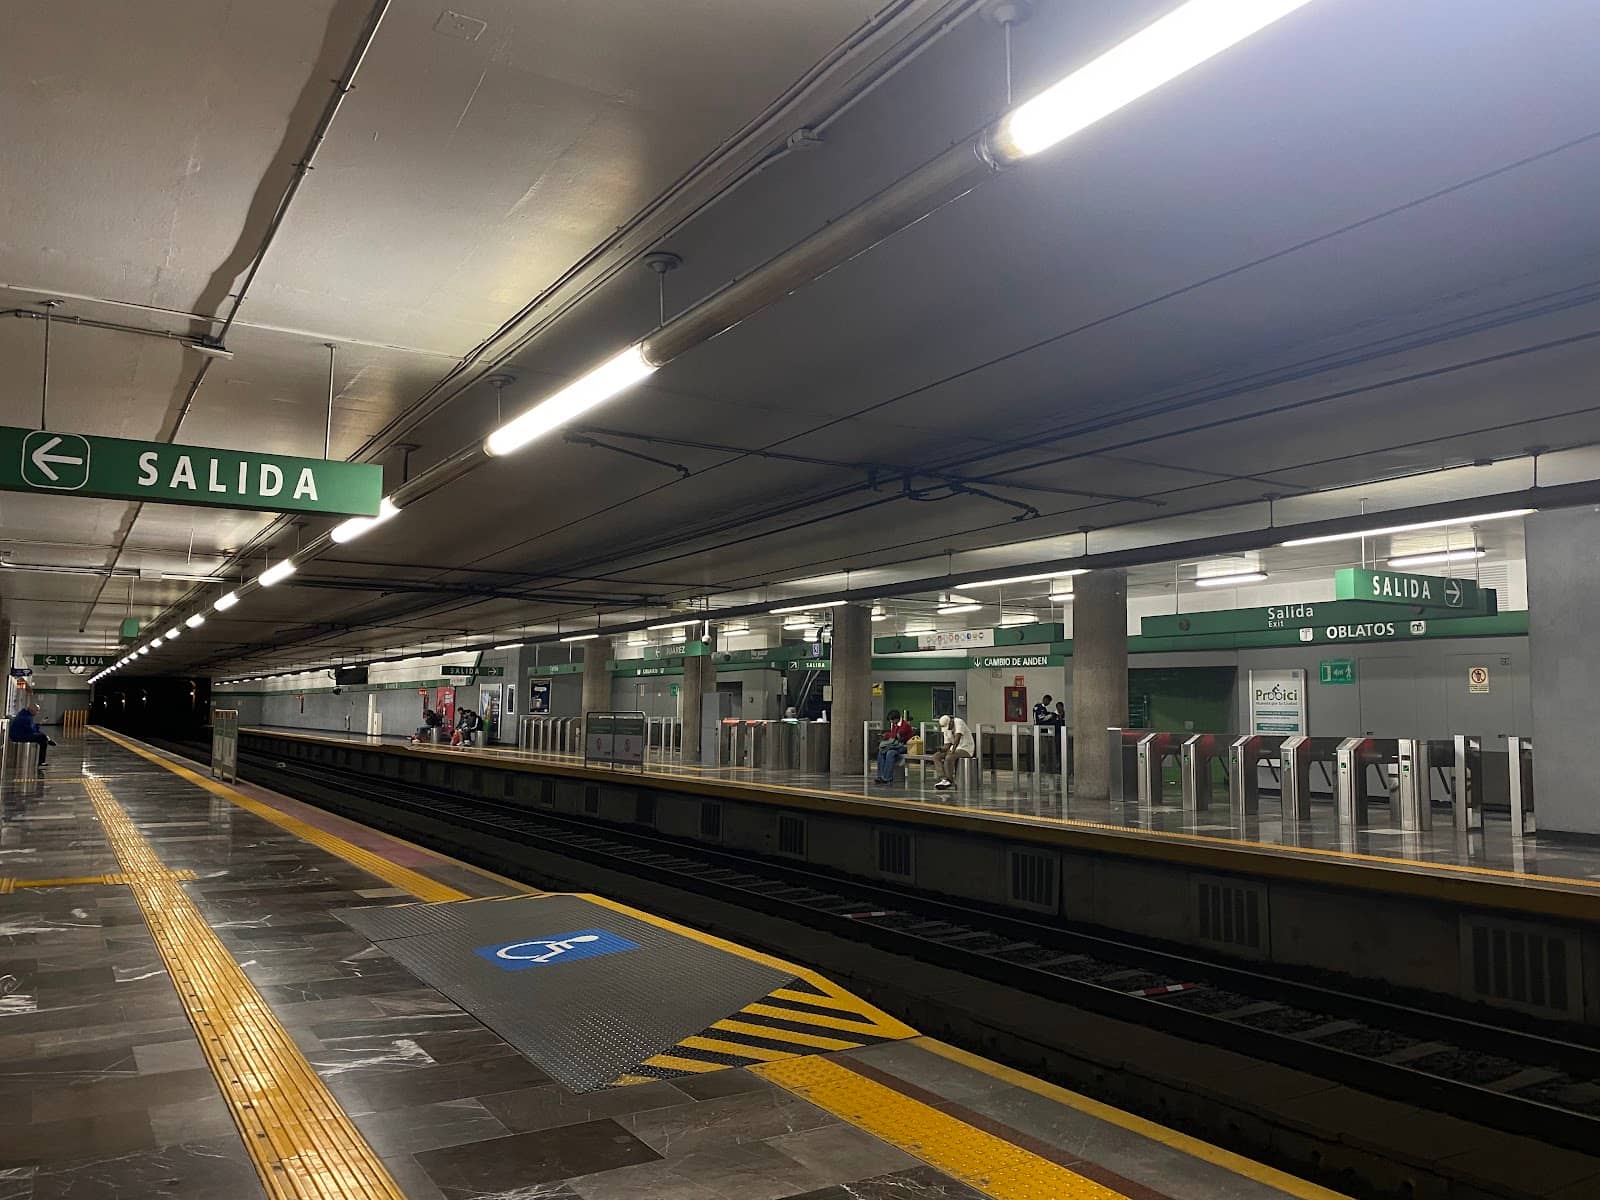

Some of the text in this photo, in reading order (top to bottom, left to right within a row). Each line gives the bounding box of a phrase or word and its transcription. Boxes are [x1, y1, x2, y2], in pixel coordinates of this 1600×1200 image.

[137, 451, 319, 501] SALIDA
[1372, 575, 1431, 600] SALIDA
[1267, 604, 1314, 620] Salida
[1268, 620, 1284, 628] Exit
[1326, 622, 1395, 639] OBLATOS
[65, 656, 104, 665] SALIDA
[984, 657, 1011, 667] CAMBIO
[1012, 657, 1022, 666] DE
[450, 667, 480, 675] SALIDA
